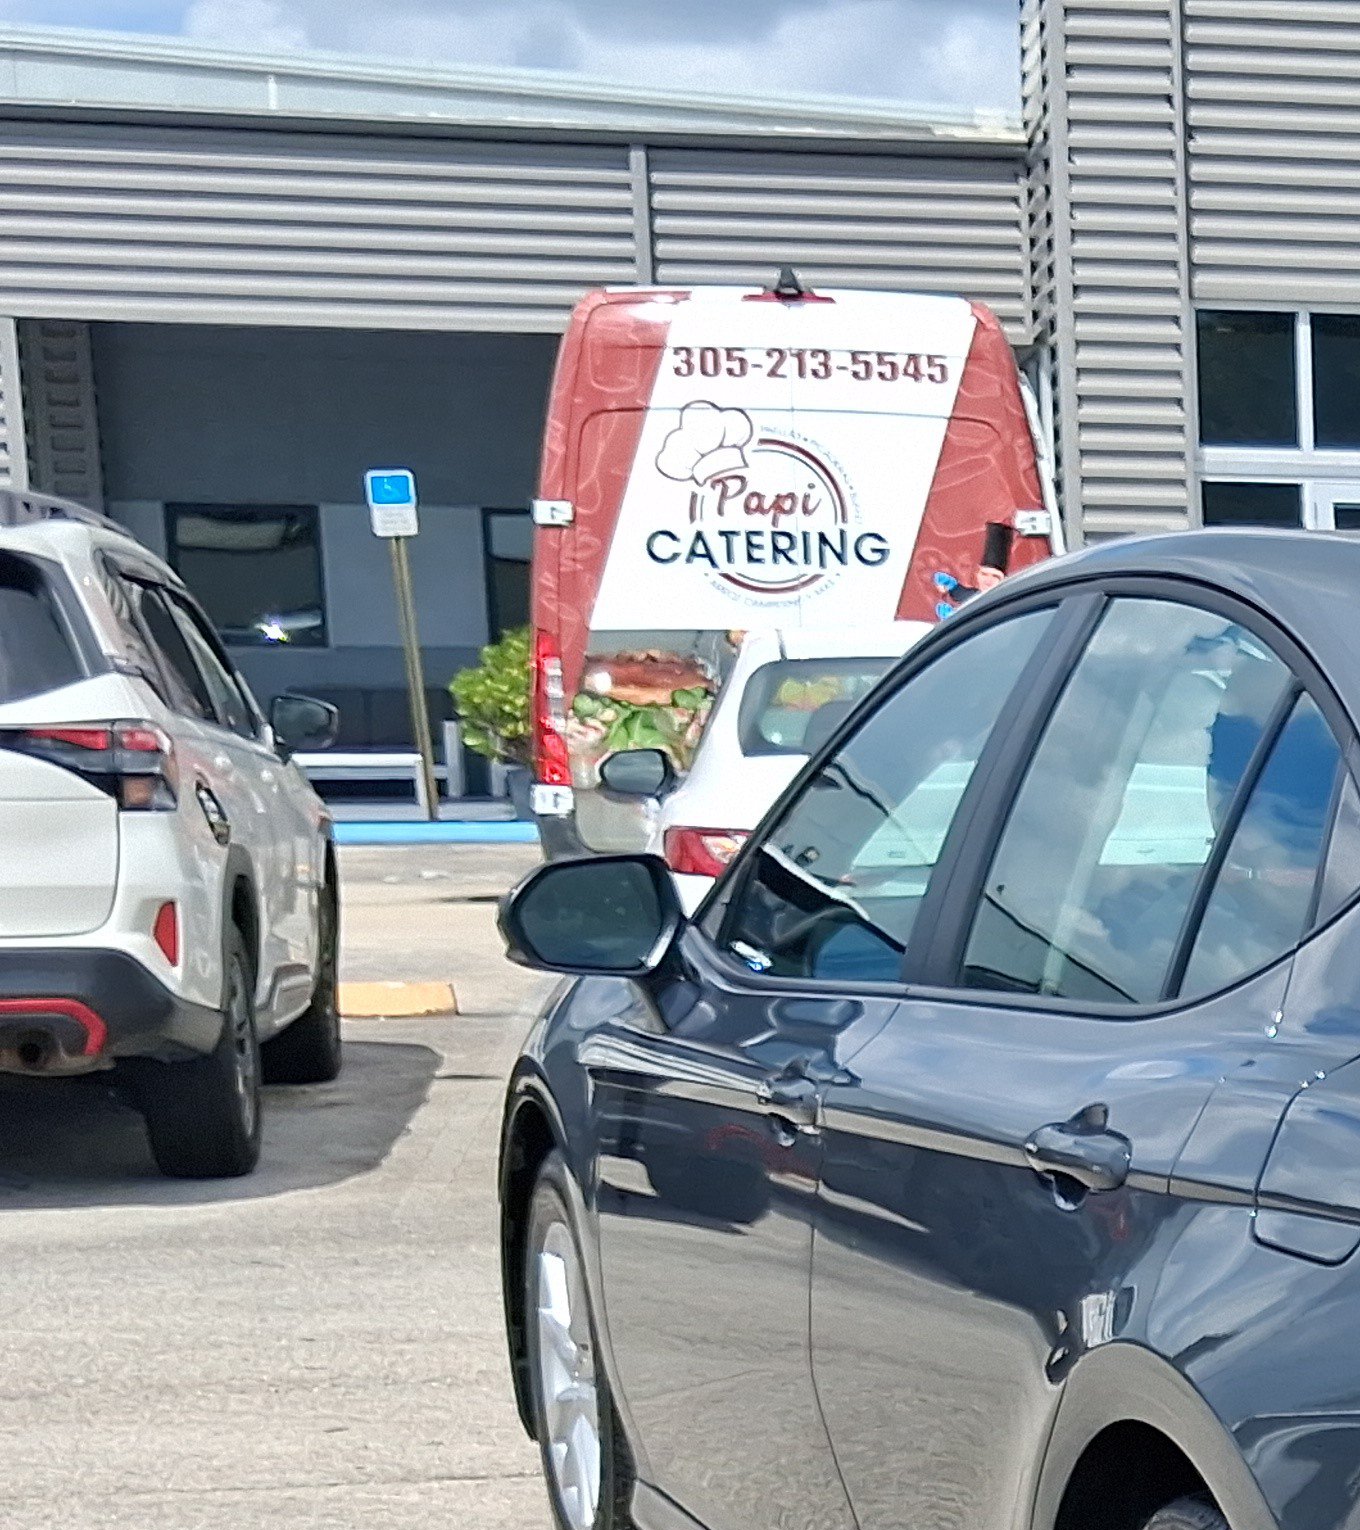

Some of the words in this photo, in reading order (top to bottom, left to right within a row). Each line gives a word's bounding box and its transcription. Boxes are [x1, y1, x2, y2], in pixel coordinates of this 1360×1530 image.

[672, 346, 950, 384] 305-213-5545
[710, 474, 823, 529] Papi
[645, 528, 890, 569] CATERING
